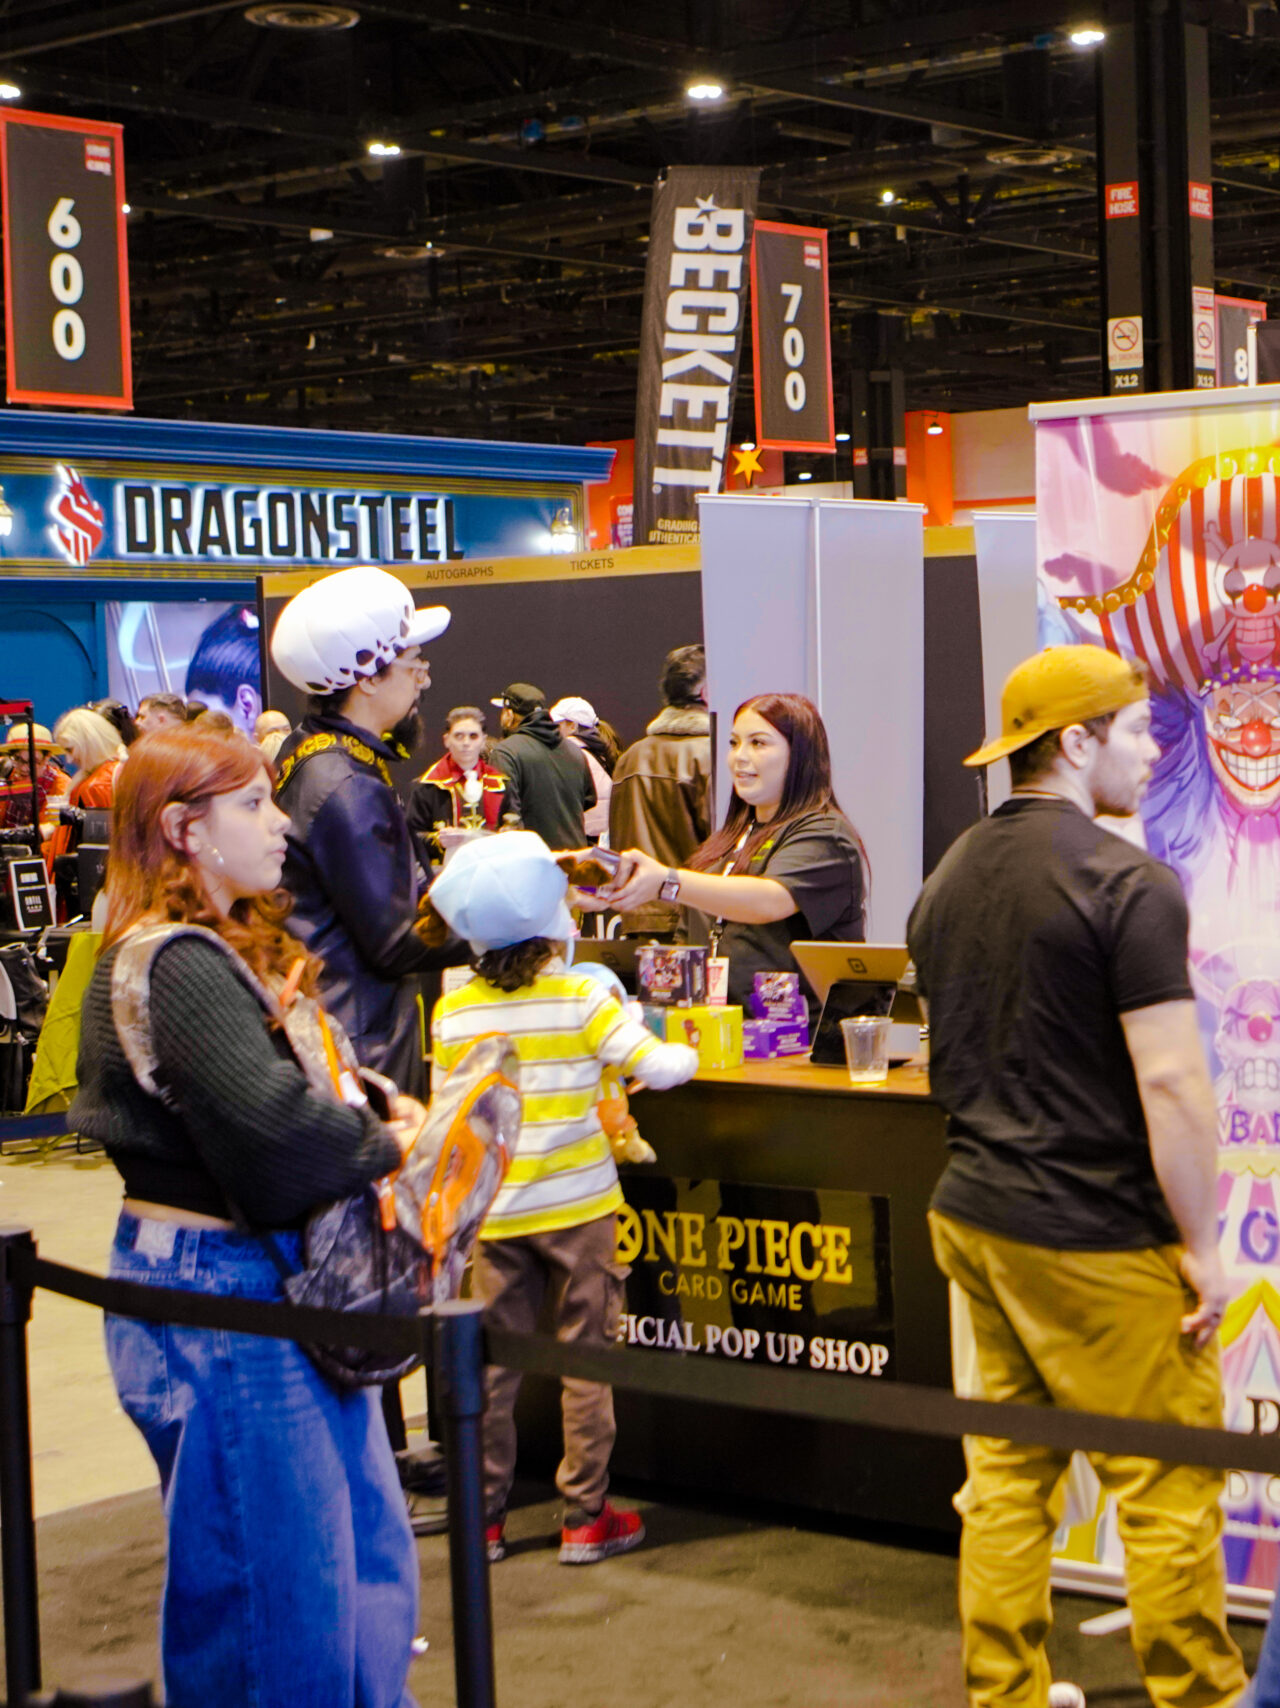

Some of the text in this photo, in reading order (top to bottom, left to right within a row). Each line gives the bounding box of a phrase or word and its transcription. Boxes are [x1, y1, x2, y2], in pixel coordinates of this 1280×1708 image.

[1111, 187, 1134, 201] FIRE
[48, 197, 86, 361] 600
[653, 207, 747, 494] BECKETT
[781, 283, 805, 411] 700
[1115, 374, 1139, 388] X12
[126, 485, 465, 560] DRAGONSTEEL
[426, 566, 494, 581] AUTOGRAPHS
[570, 557, 615, 572] TICKETS
[614, 1202, 854, 1285] ONE PIECE
[658, 1270, 803, 1312] CARD GAME
[705, 1324, 760, 1359] POP
[765, 1331, 805, 1364] UP
[809, 1337, 889, 1377] SHOP
